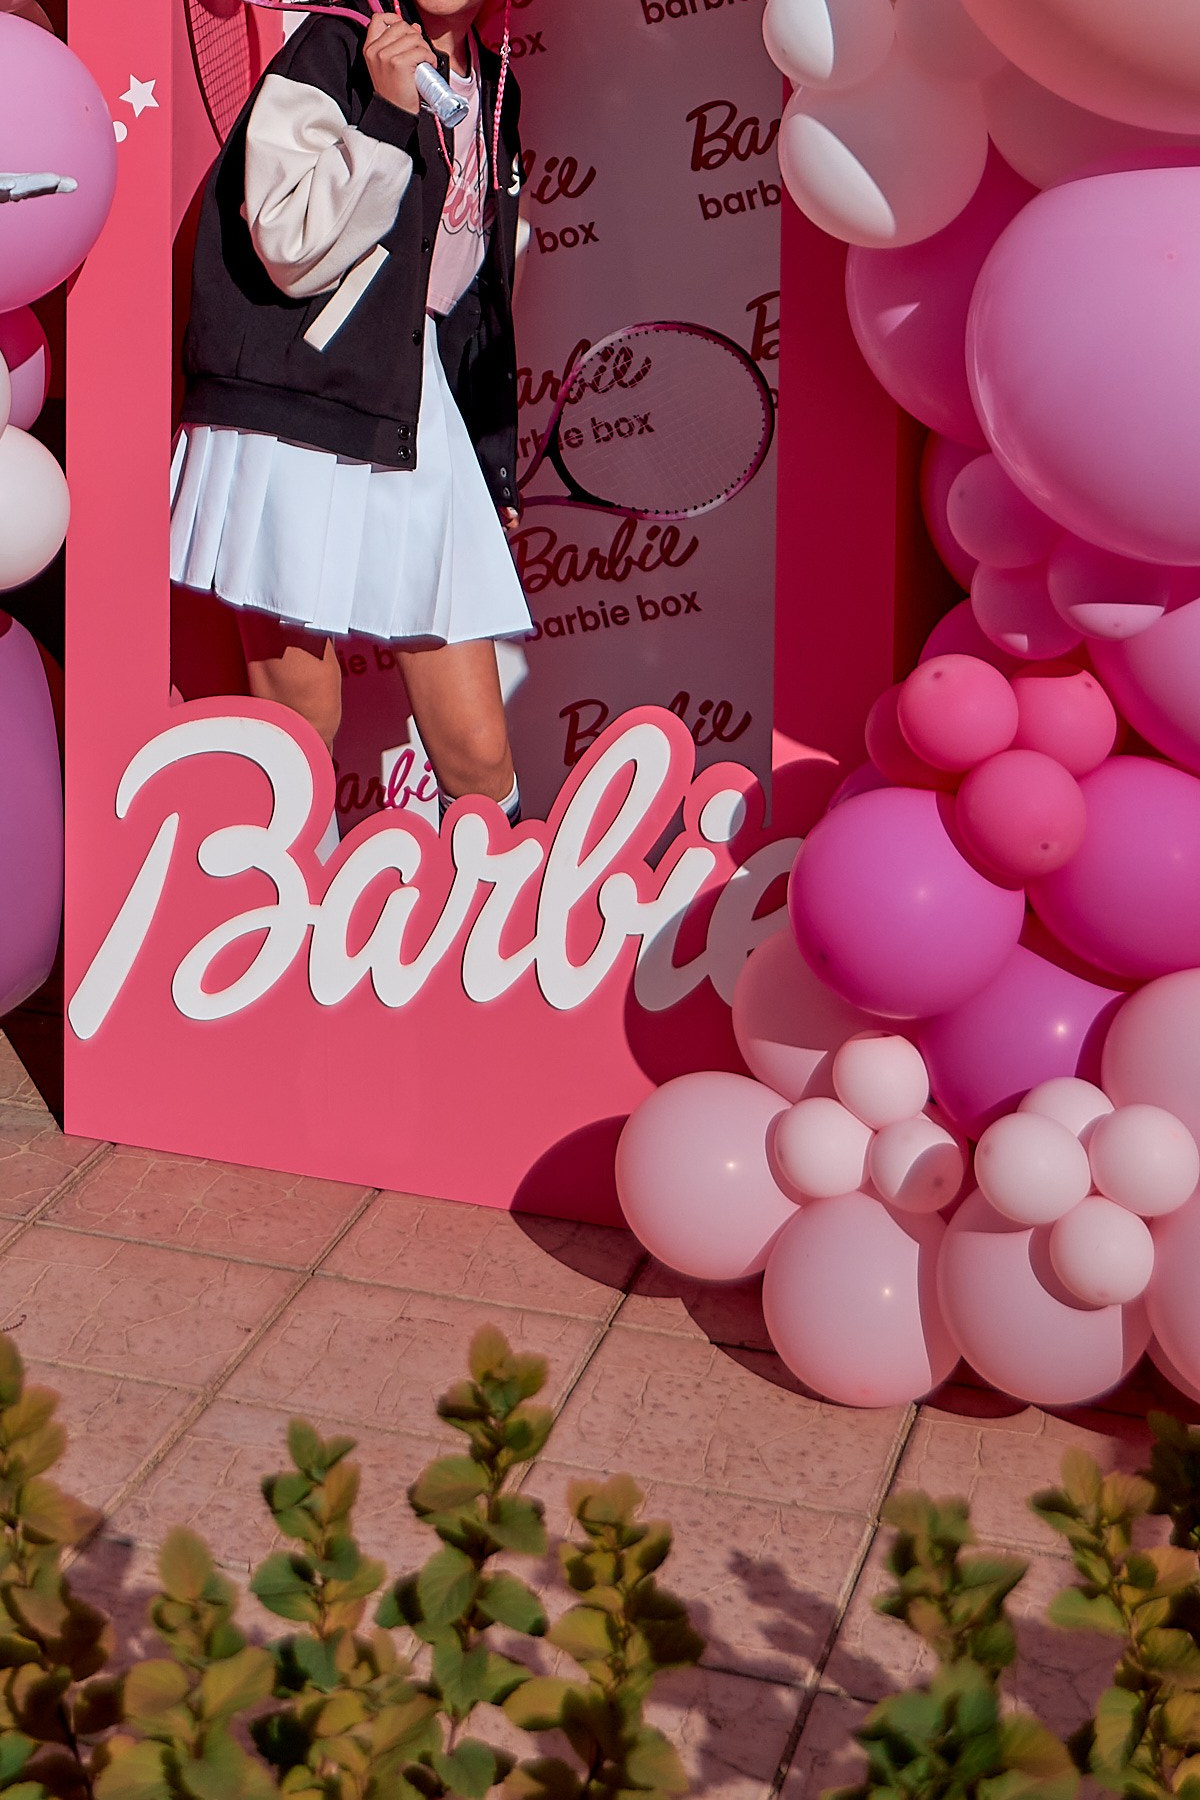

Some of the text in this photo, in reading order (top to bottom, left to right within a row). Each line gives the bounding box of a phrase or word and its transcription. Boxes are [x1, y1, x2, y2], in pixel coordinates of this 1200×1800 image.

[500, 31, 547, 58] ox
[699, 179, 781, 221] barb
[535, 221, 600, 254] box
[590, 411, 655, 443] box
[508, 517, 699, 594] Barbie
[636, 591, 702, 622] box
[334, 748, 438, 813] arbi
